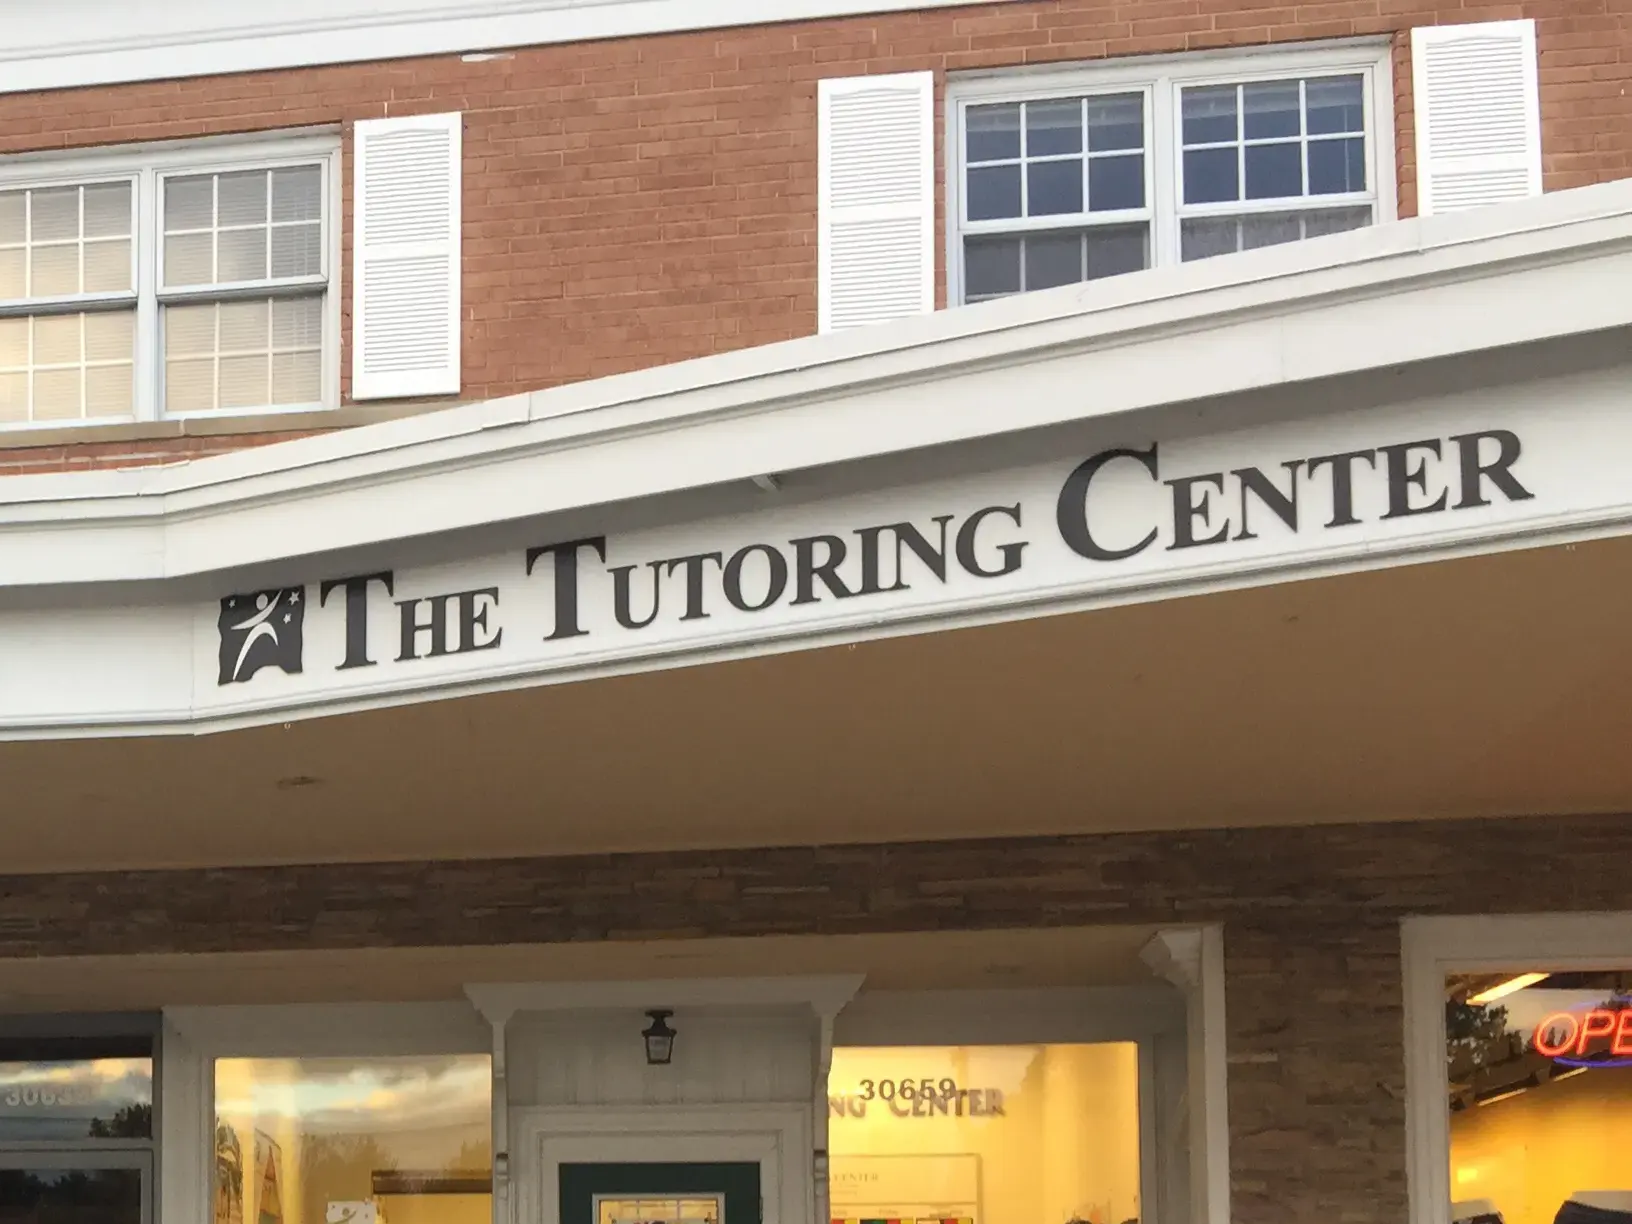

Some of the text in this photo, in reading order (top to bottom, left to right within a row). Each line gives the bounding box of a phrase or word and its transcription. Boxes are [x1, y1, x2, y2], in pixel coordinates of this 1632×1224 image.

[320, 429, 1535, 670] THE TUTORING CENTER
[859, 1078, 957, 1101] 30659
[888, 1087, 1006, 1118] CENTER
